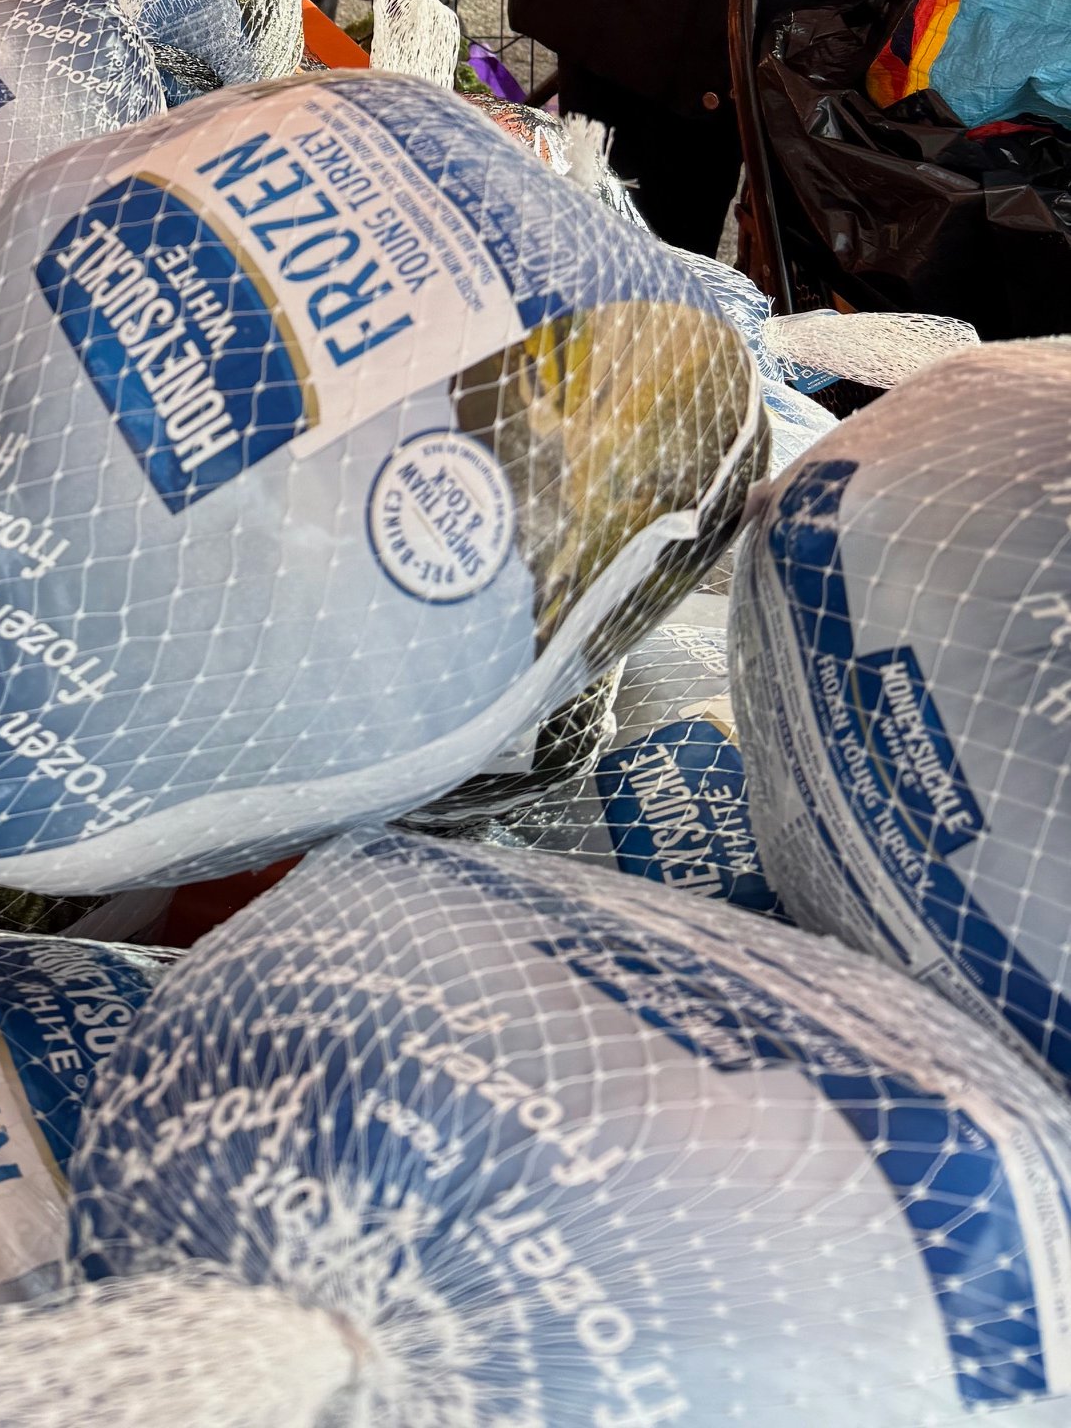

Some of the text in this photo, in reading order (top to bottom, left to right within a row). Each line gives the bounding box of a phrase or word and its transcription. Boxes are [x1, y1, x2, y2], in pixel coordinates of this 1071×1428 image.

[2, 12, 92, 47] frozen
[47, 56, 123, 96] frozen
[195, 132, 419, 368] FROZEN
[293, 127, 439, 294] YOUNG TURKEY
[439, 251, 463, 276] WITH
[55, 219, 243, 474] HONEYSUCKLE
[152, 242, 238, 359] WHITE
[383, 489, 455, 584] PRE-BRINED
[397, 461, 485, 578] THAW SIMPLY
[430, 465, 485, 534] & COOK
[816, 652, 935, 899] FROZEN YOUNG TURKEY
[878, 661, 975, 835] HONEYSUCKLE
[619, 743, 724, 899] NEYSUCKLE
[704, 784, 760, 878] WHITE
[14, 980, 83, 1073] WHITE
[399, 1030, 625, 1188] frozen
